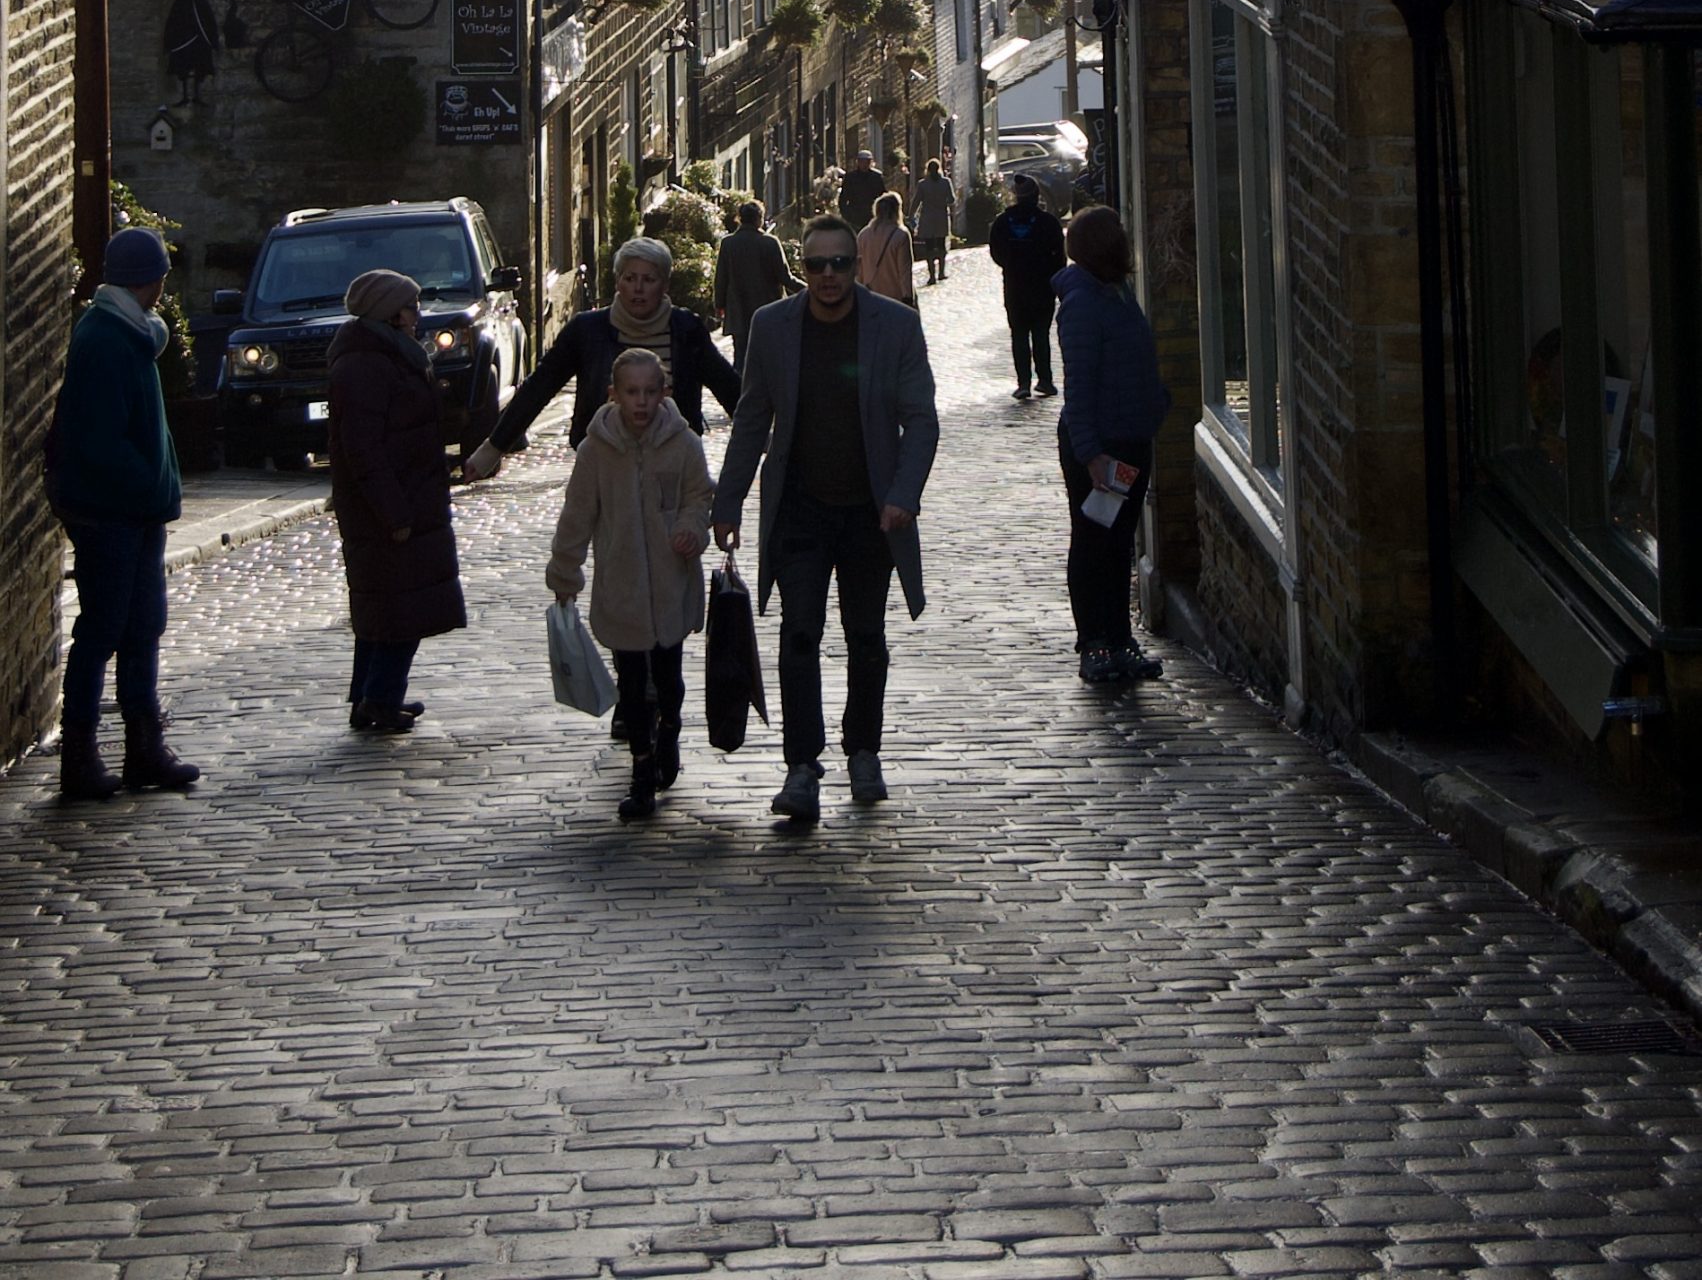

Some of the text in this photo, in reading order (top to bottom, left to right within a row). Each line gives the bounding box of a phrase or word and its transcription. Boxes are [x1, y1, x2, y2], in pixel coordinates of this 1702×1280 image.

[458, 3, 514, 18] Oh La La
[461, 23, 511, 36] Vintage
[287, 327, 334, 337] LAND
